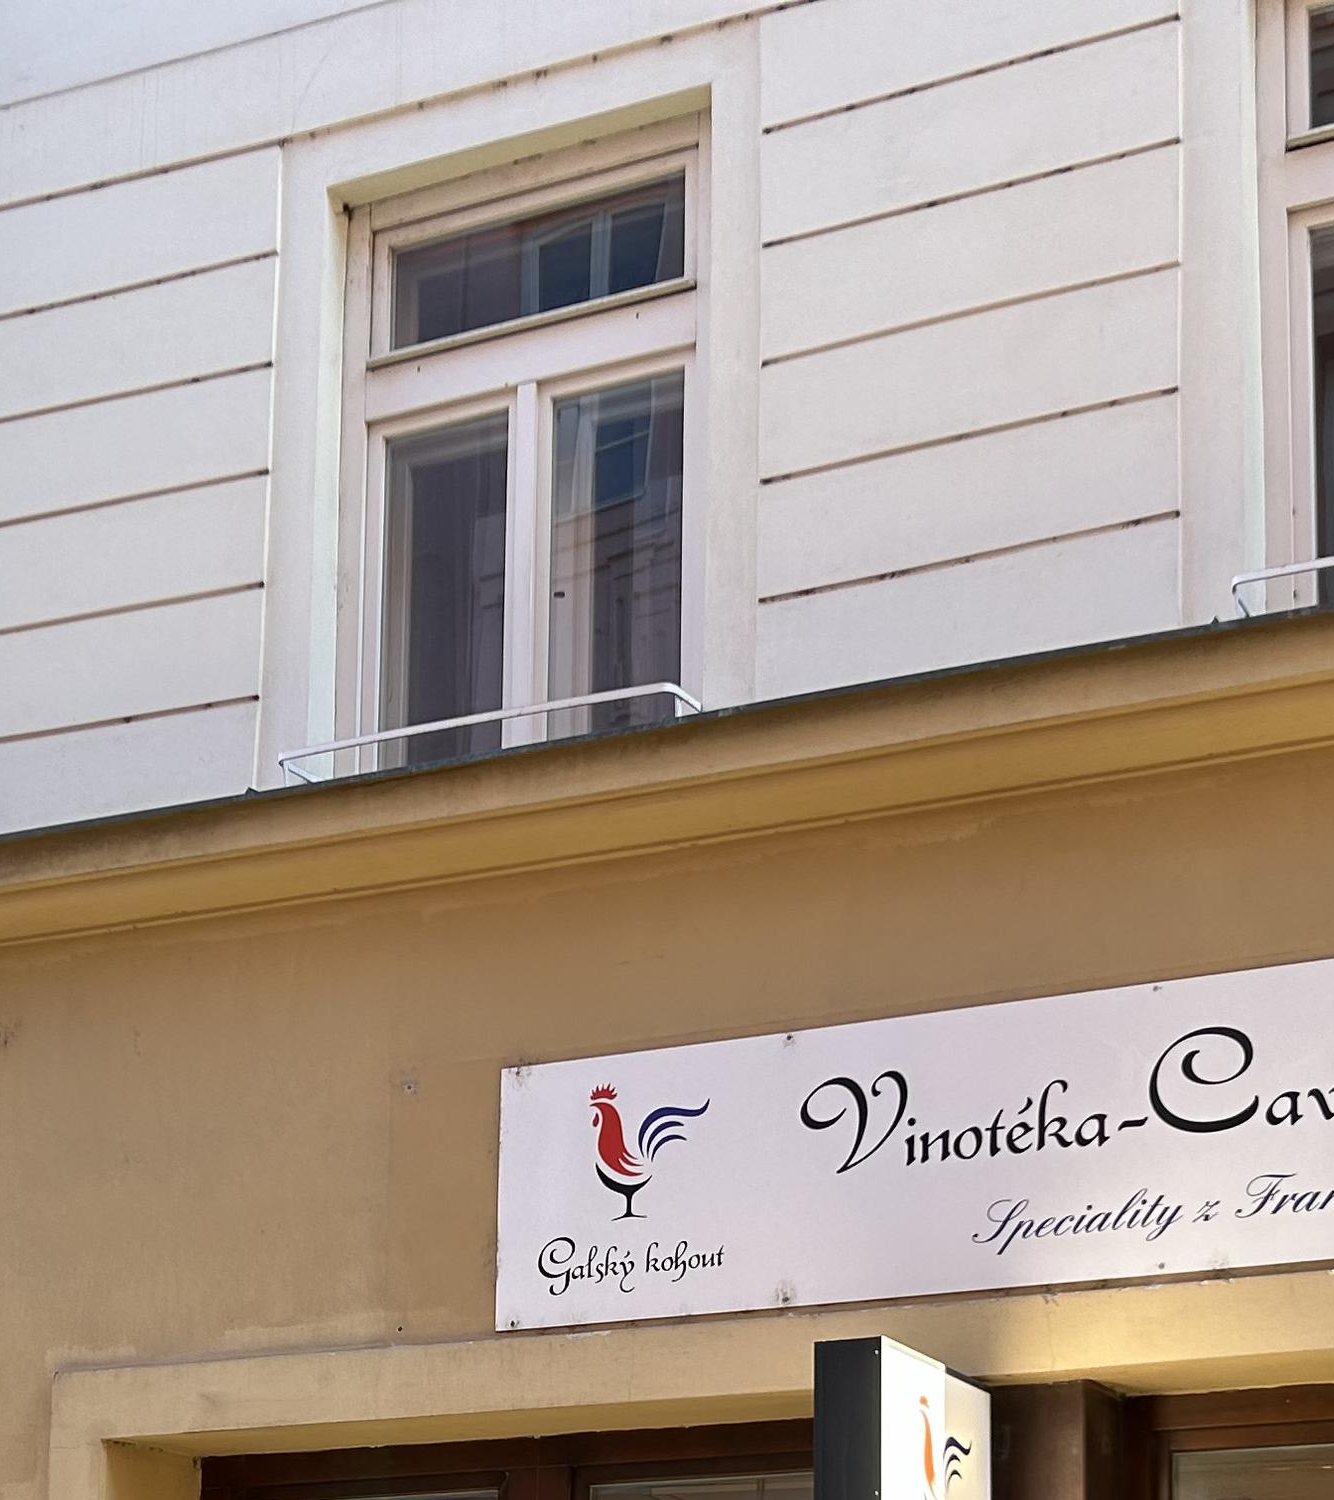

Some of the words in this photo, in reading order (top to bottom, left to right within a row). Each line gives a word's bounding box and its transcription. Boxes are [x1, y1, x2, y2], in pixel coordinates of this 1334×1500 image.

[972, 1187, 1183, 1255] Speciality
[1192, 1200, 1221, 1222] z
[538, 1237, 635, 1296] Galský
[646, 1240, 725, 1283] kohout
